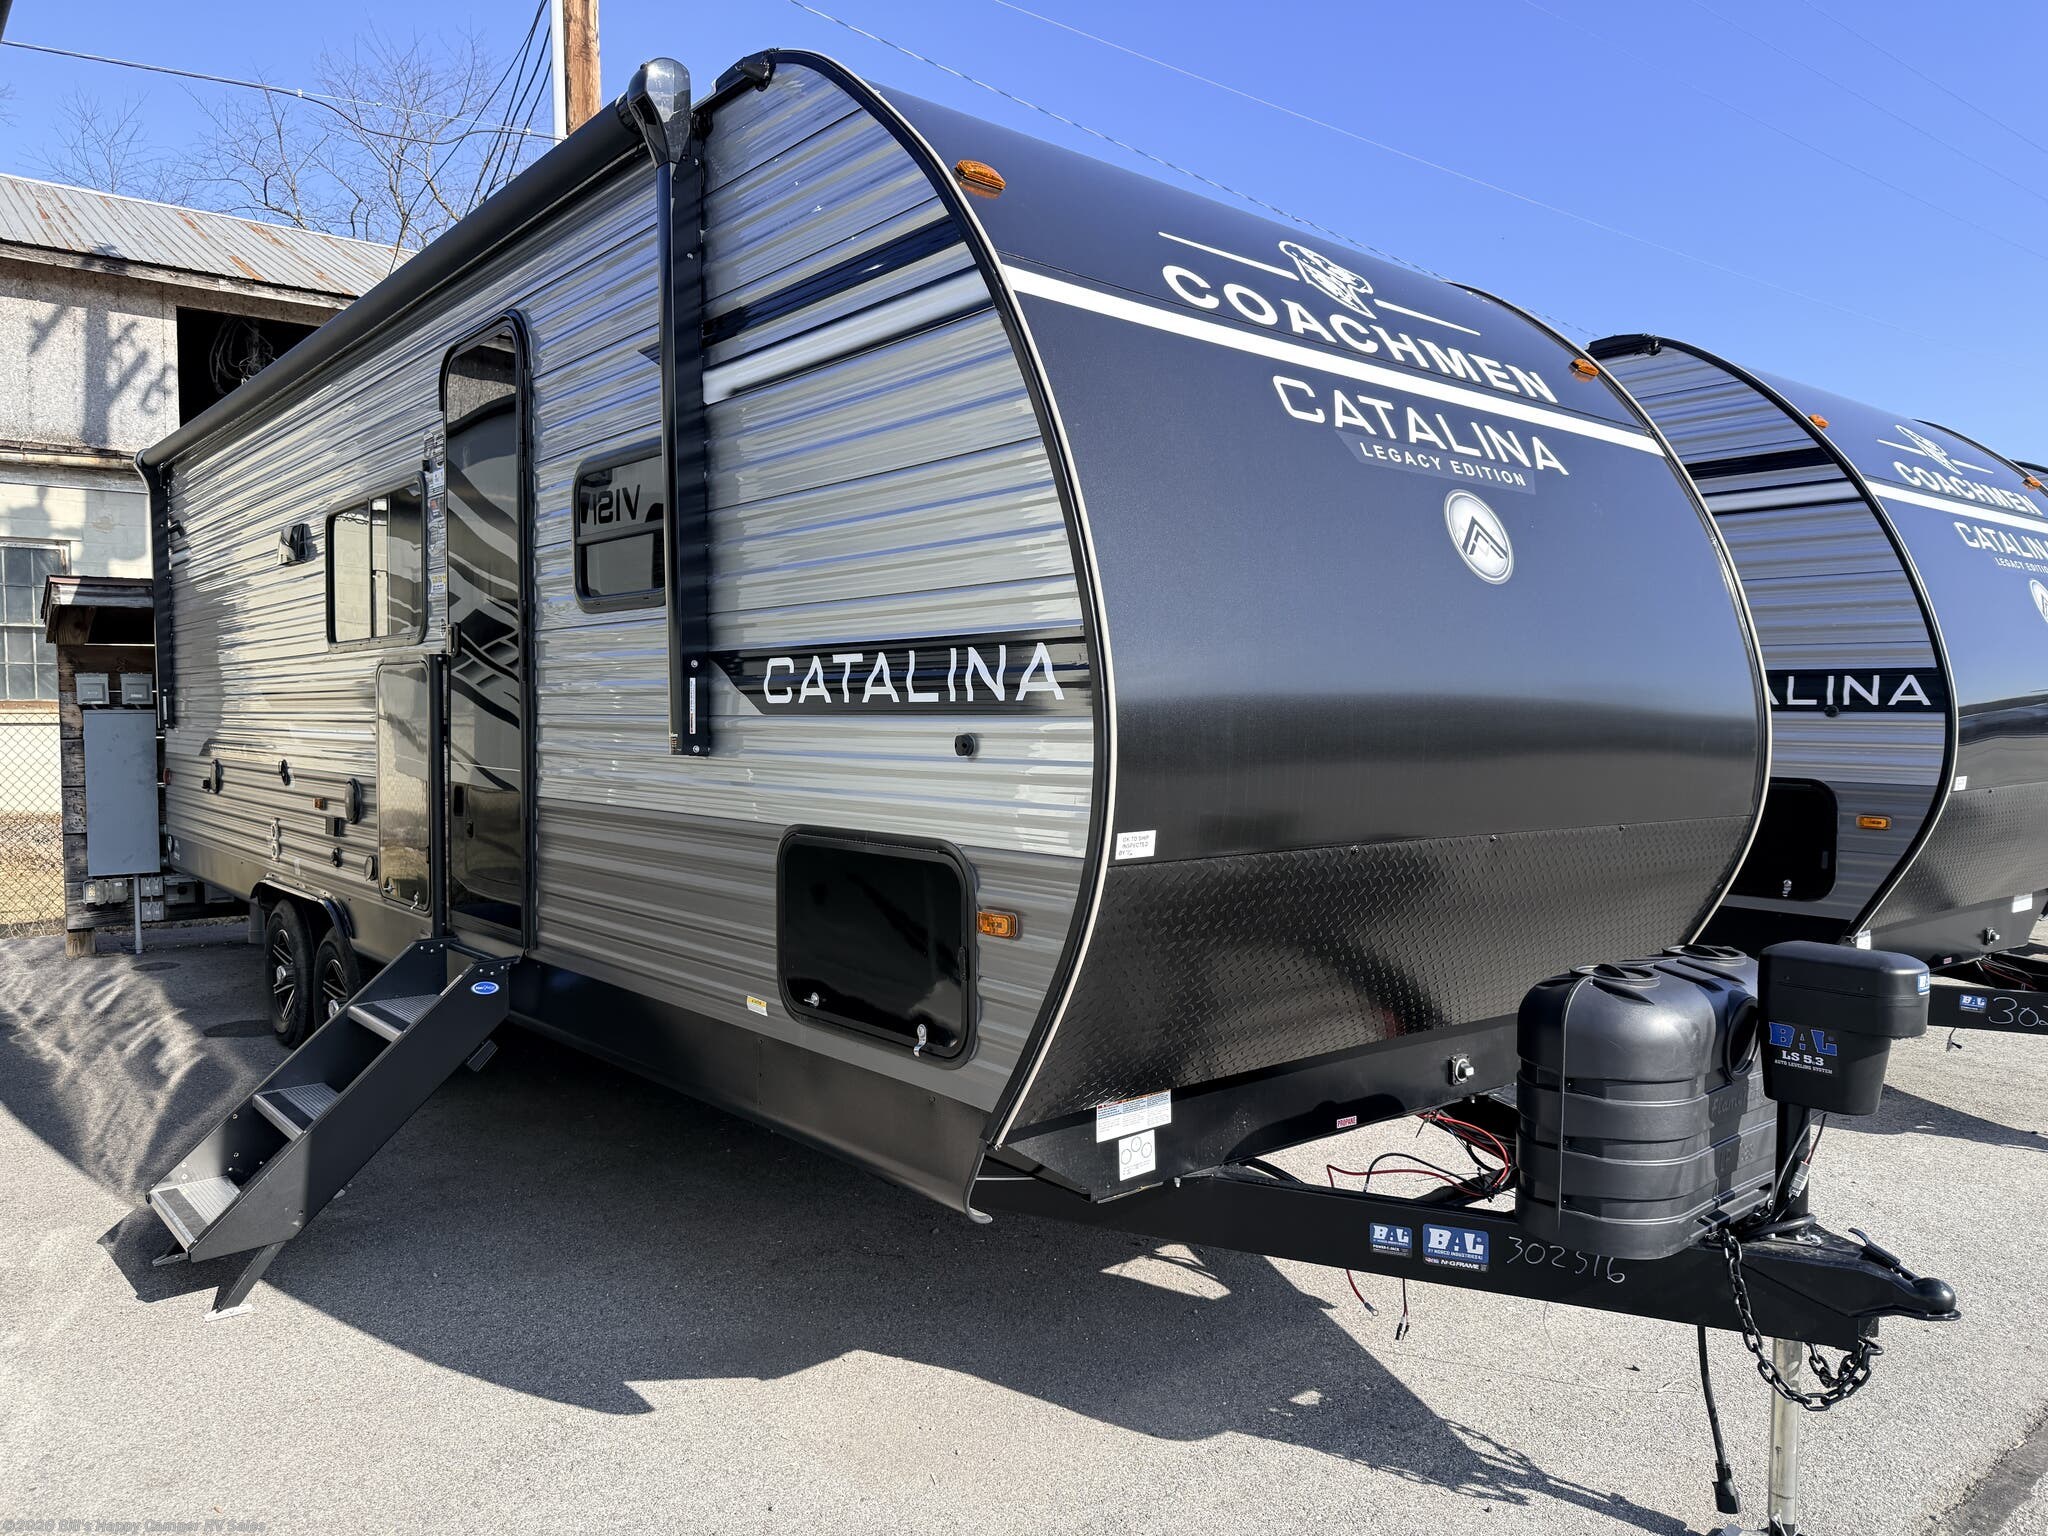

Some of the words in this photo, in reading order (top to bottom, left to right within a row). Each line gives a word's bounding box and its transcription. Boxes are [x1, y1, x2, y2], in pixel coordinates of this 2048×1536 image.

[1162, 264, 1558, 403] COACHMEN
[1272, 375, 1570, 476] CATALINA
[1360, 441, 1442, 471] LEGACY
[1450, 460, 1527, 486] EDITION
[1893, 461, 2043, 516] COACHMEN
[1953, 521, 2048, 560] CATALIN
[763, 642, 1065, 704] CATALINA
[1769, 1022, 1837, 1056] BAL
[1782, 1050, 1800, 1061] LS
[1373, 1225, 1409, 1244] BAL
[1428, 1228, 1485, 1255] BAL
